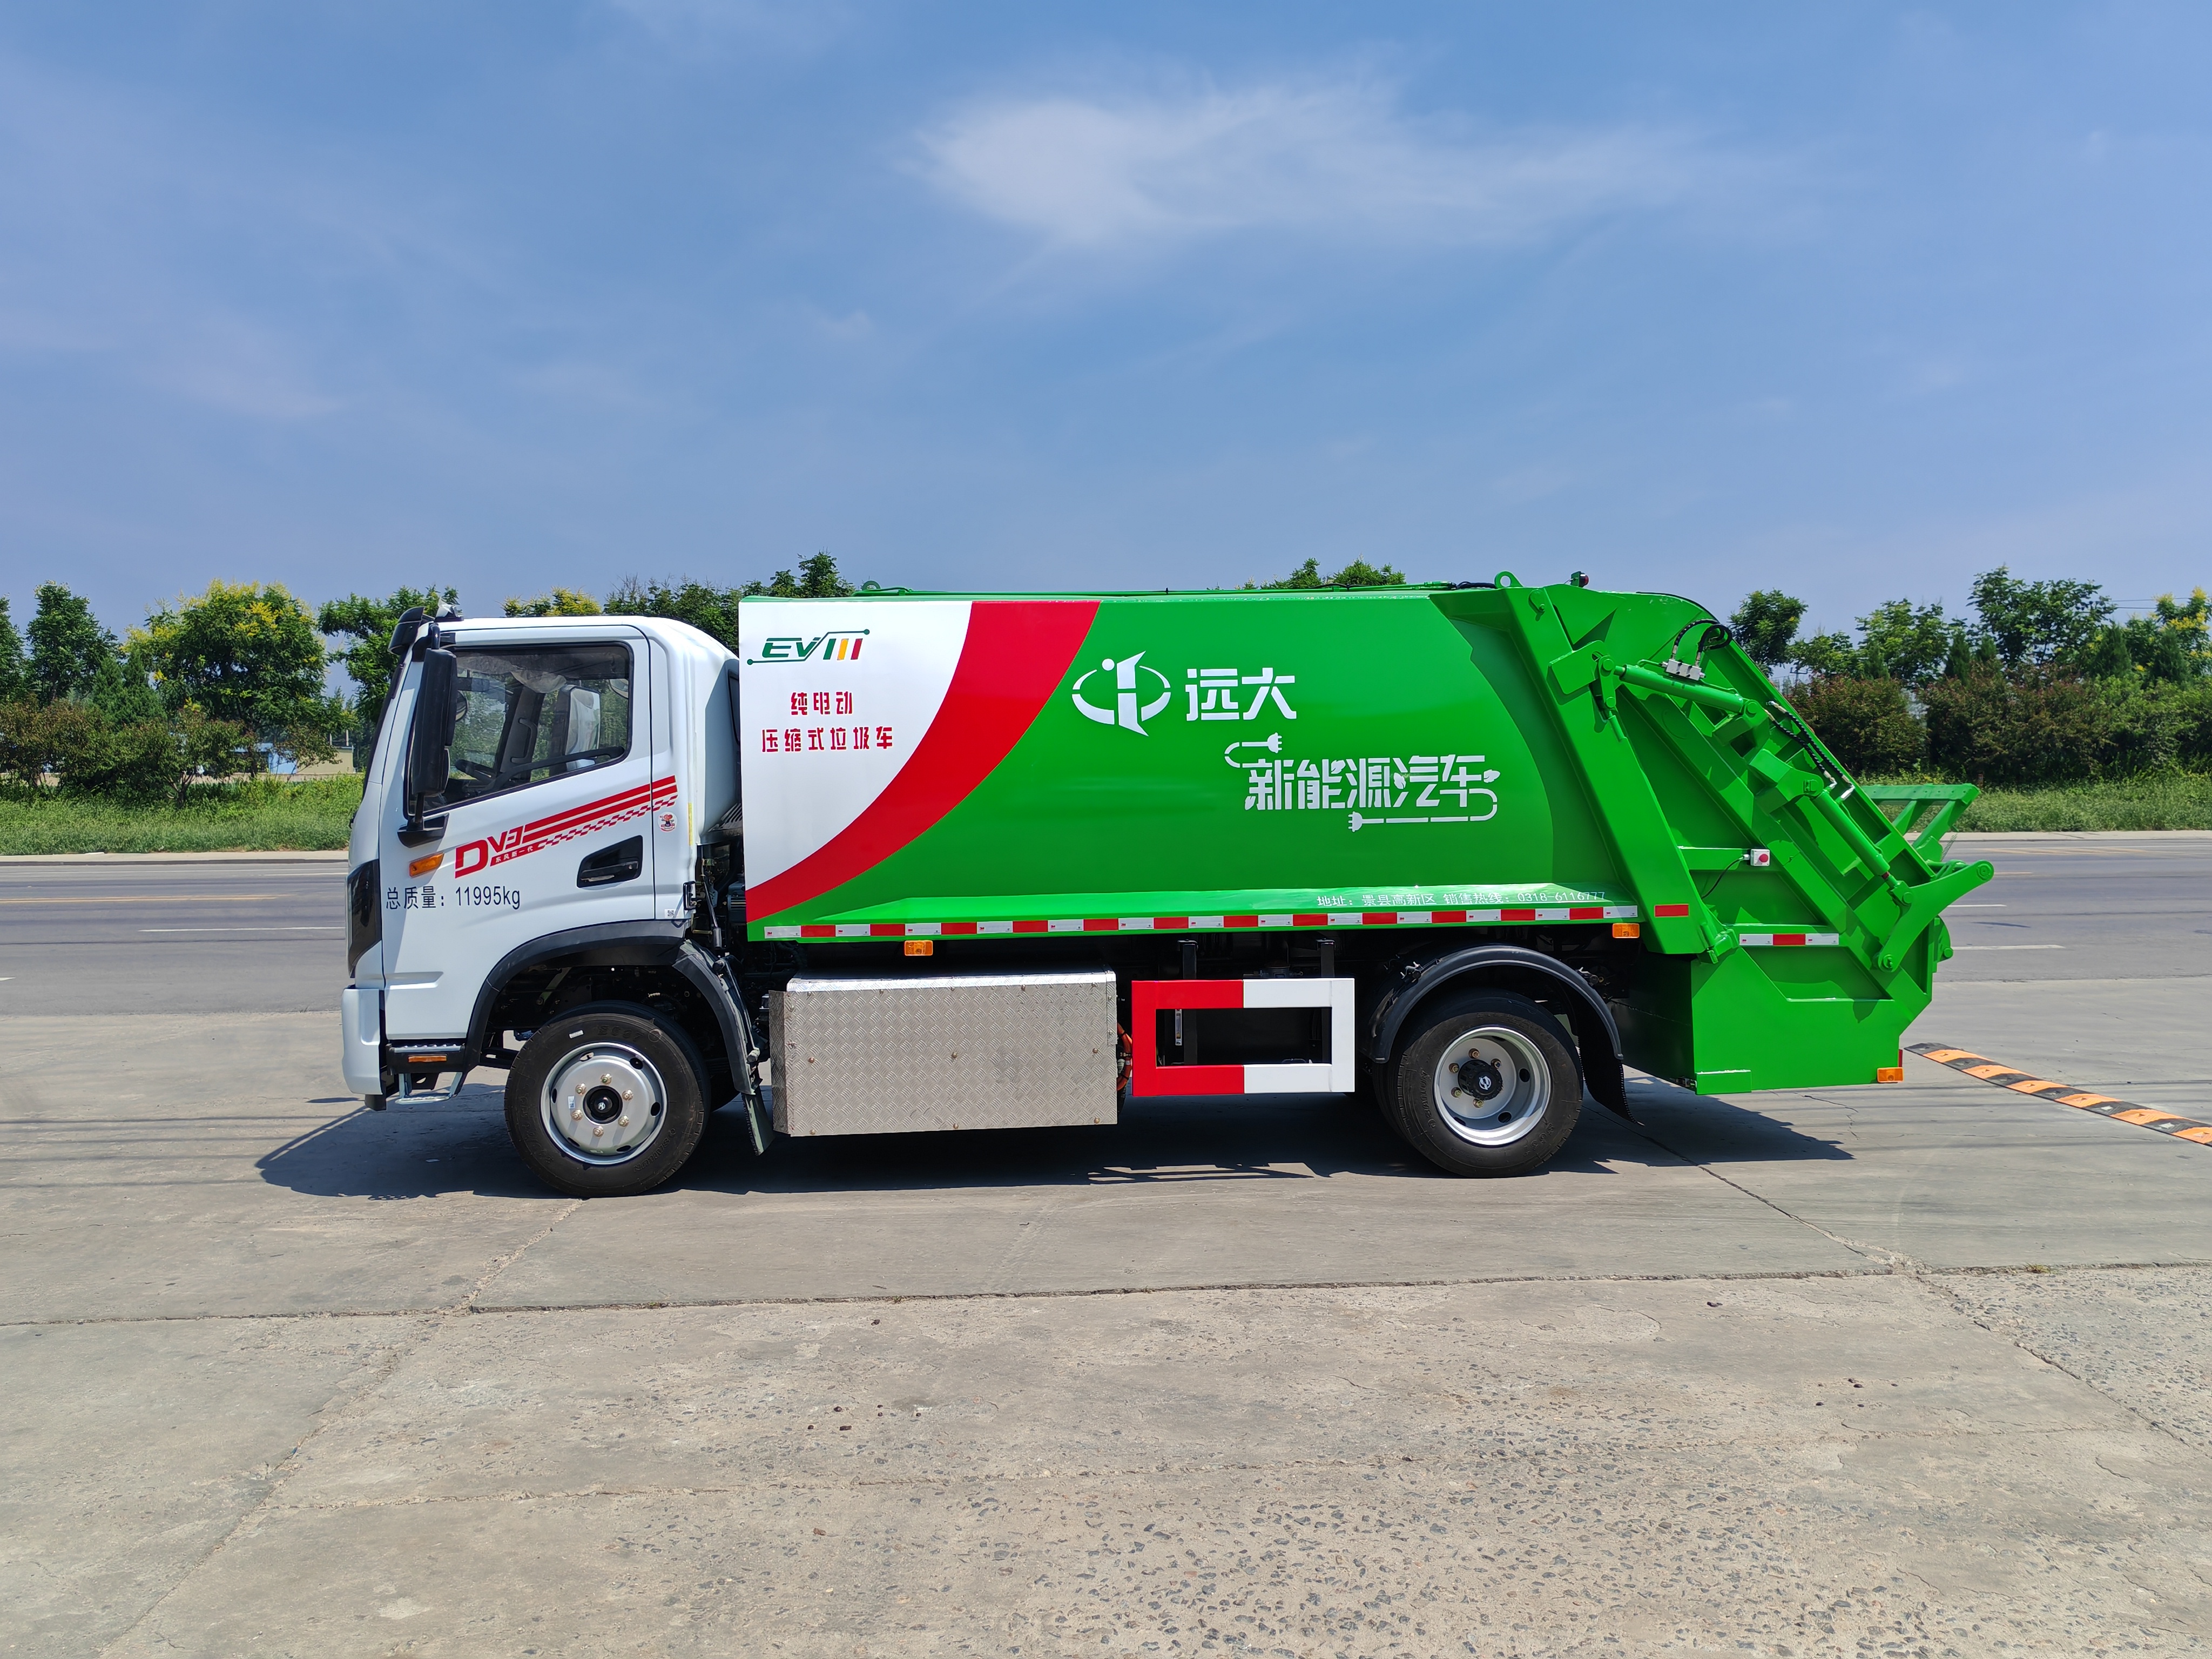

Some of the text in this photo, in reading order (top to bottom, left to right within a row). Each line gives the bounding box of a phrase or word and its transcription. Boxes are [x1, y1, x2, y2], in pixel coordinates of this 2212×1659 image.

[791, 692, 853, 715] 纯电动
[1185, 667, 1297, 720] 远大
[762, 726, 893, 752] 压缩式垃圾车
[1244, 754, 1486, 811] 新能源汽车
